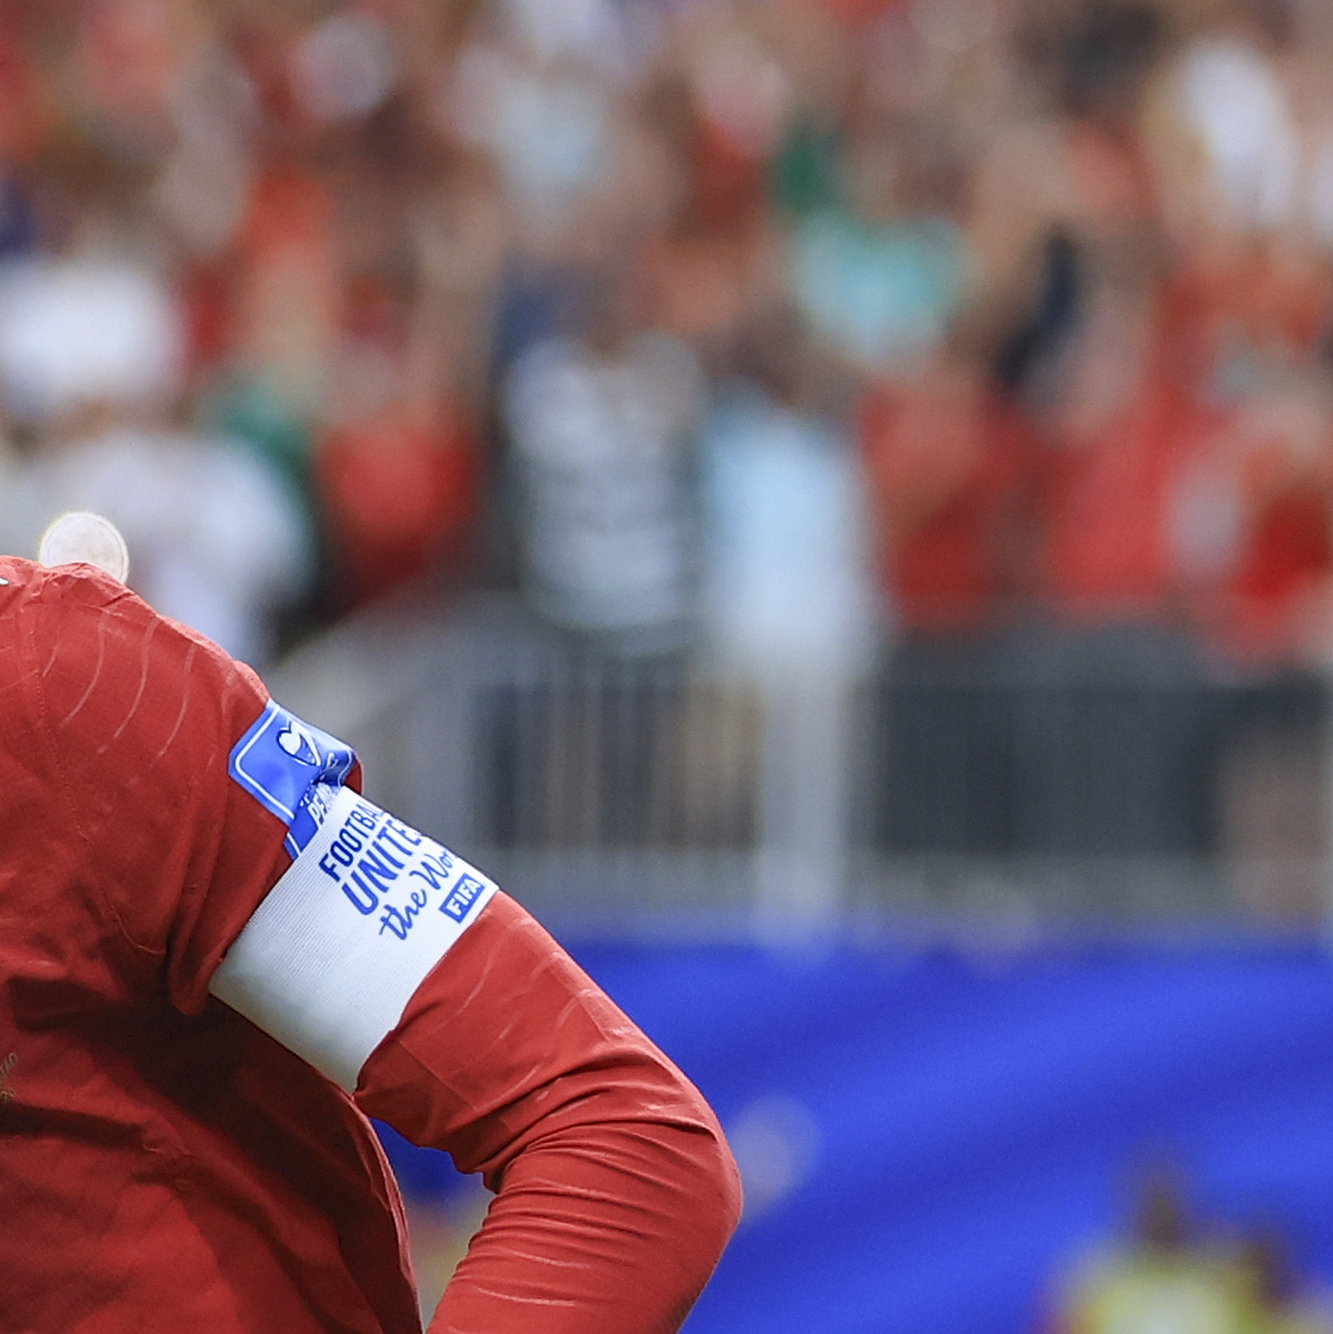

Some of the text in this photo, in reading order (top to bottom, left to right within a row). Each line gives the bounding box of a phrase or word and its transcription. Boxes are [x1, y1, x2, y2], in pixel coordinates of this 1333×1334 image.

[341, 819, 423, 915] UNITE
[379, 851, 454, 940] the Wor
[450, 875, 484, 921] FIFA
